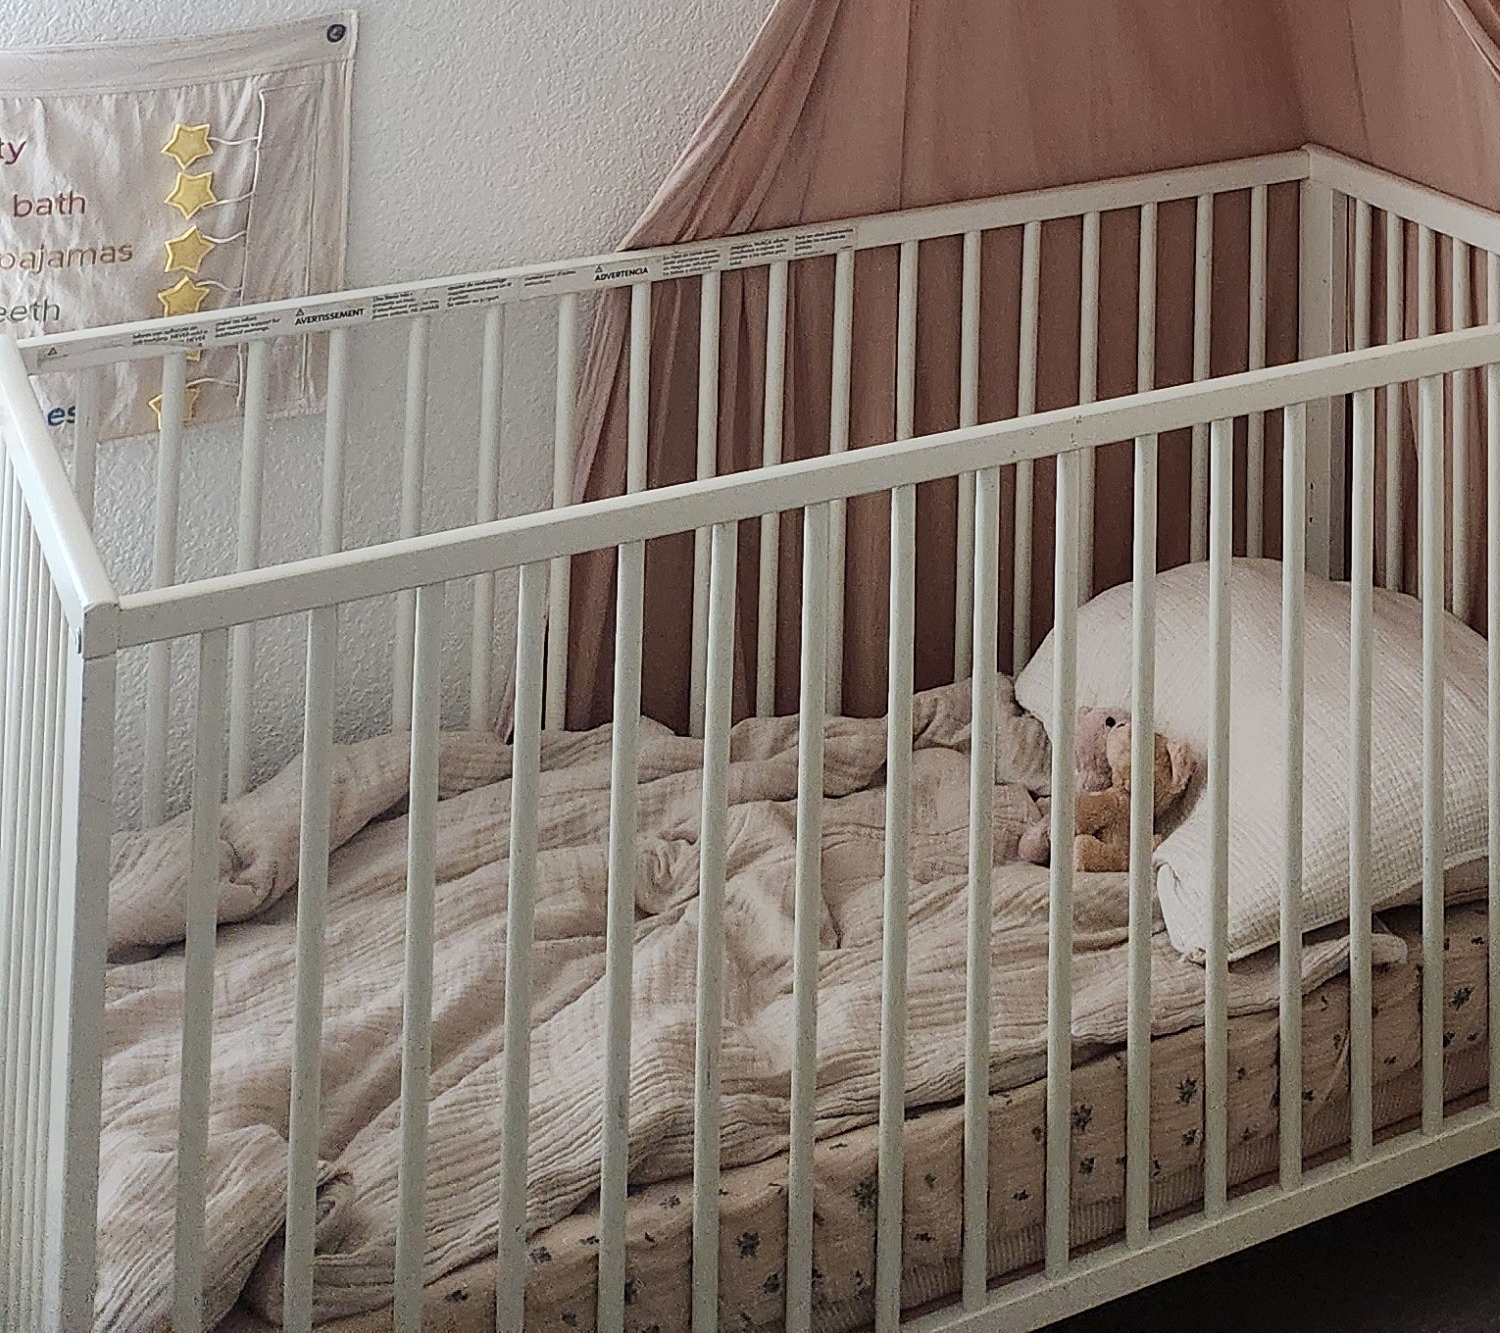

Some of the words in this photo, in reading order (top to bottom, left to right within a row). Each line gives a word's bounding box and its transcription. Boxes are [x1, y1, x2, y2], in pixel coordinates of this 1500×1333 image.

[12, 189, 87, 219] bath
[594, 266, 649, 281] ADVERTENCIA
[294, 307, 365, 326] AVERTISSEMENT
